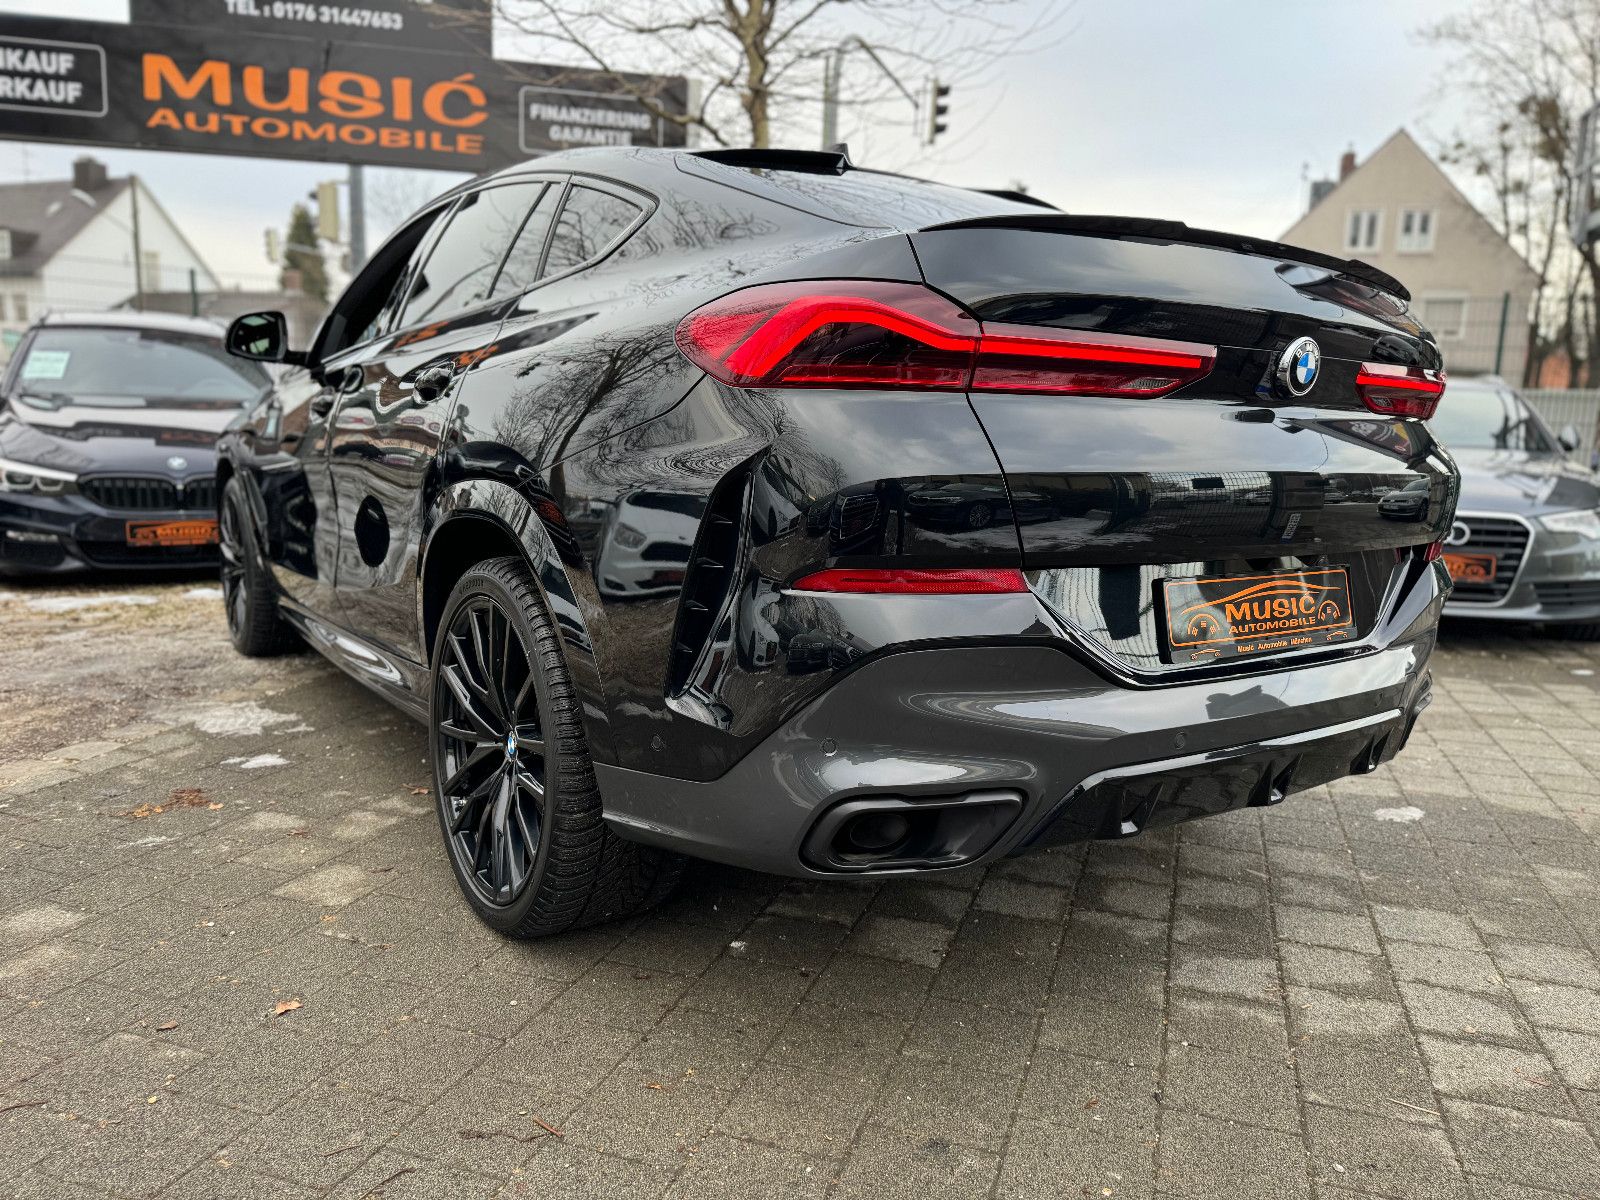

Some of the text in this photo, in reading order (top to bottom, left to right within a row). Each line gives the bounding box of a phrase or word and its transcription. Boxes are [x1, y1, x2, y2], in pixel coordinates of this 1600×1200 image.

[0, 47, 74, 75] KAUF
[142, 53, 489, 127] MUSIĆ
[530, 103, 651, 130] FINANZIERUNG
[146, 108, 485, 154] AUTOMOBILE
[549, 124, 632, 147] GARANTIE
[1228, 616, 1316, 635] AUTOMOBILE
